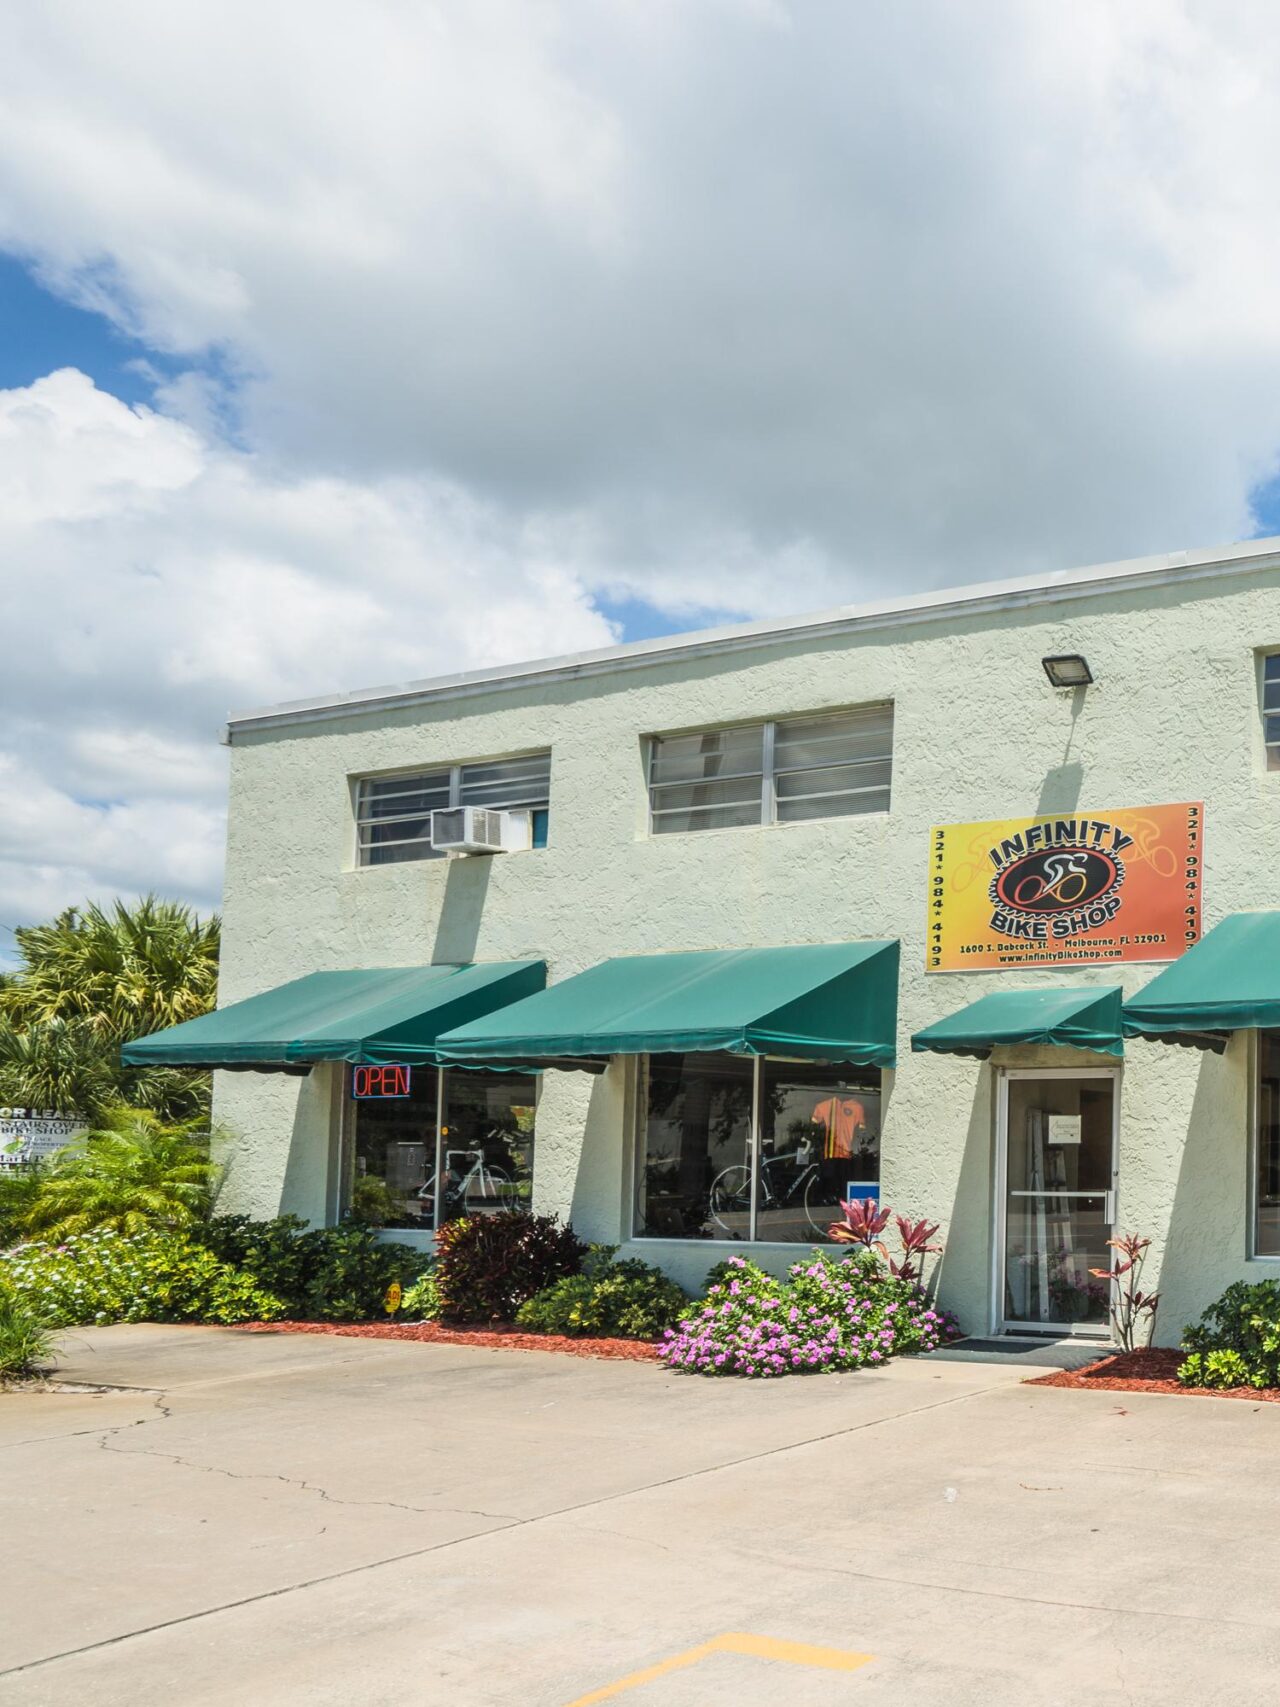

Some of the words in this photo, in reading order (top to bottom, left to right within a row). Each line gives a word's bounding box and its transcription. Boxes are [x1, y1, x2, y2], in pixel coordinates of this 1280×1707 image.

[988, 819, 1134, 869] INFINITY
[989, 909, 1049, 941] BIKE
[1051, 896, 1122, 939] SHOP
[960, 944, 984, 954] 1600
[987, 943, 995, 952] S.
[998, 940, 1035, 952] Babcock
[1037, 938, 1050, 950] St.
[1064, 937, 1117, 949] Melbourne,
[1119, 935, 1131, 945] FL
[1134, 933, 1167, 945] 32901
[356, 1066, 409, 1096] OPEN
[0, 1107, 27, 1118] OR
[0, 1120, 49, 1128] STAIRS
